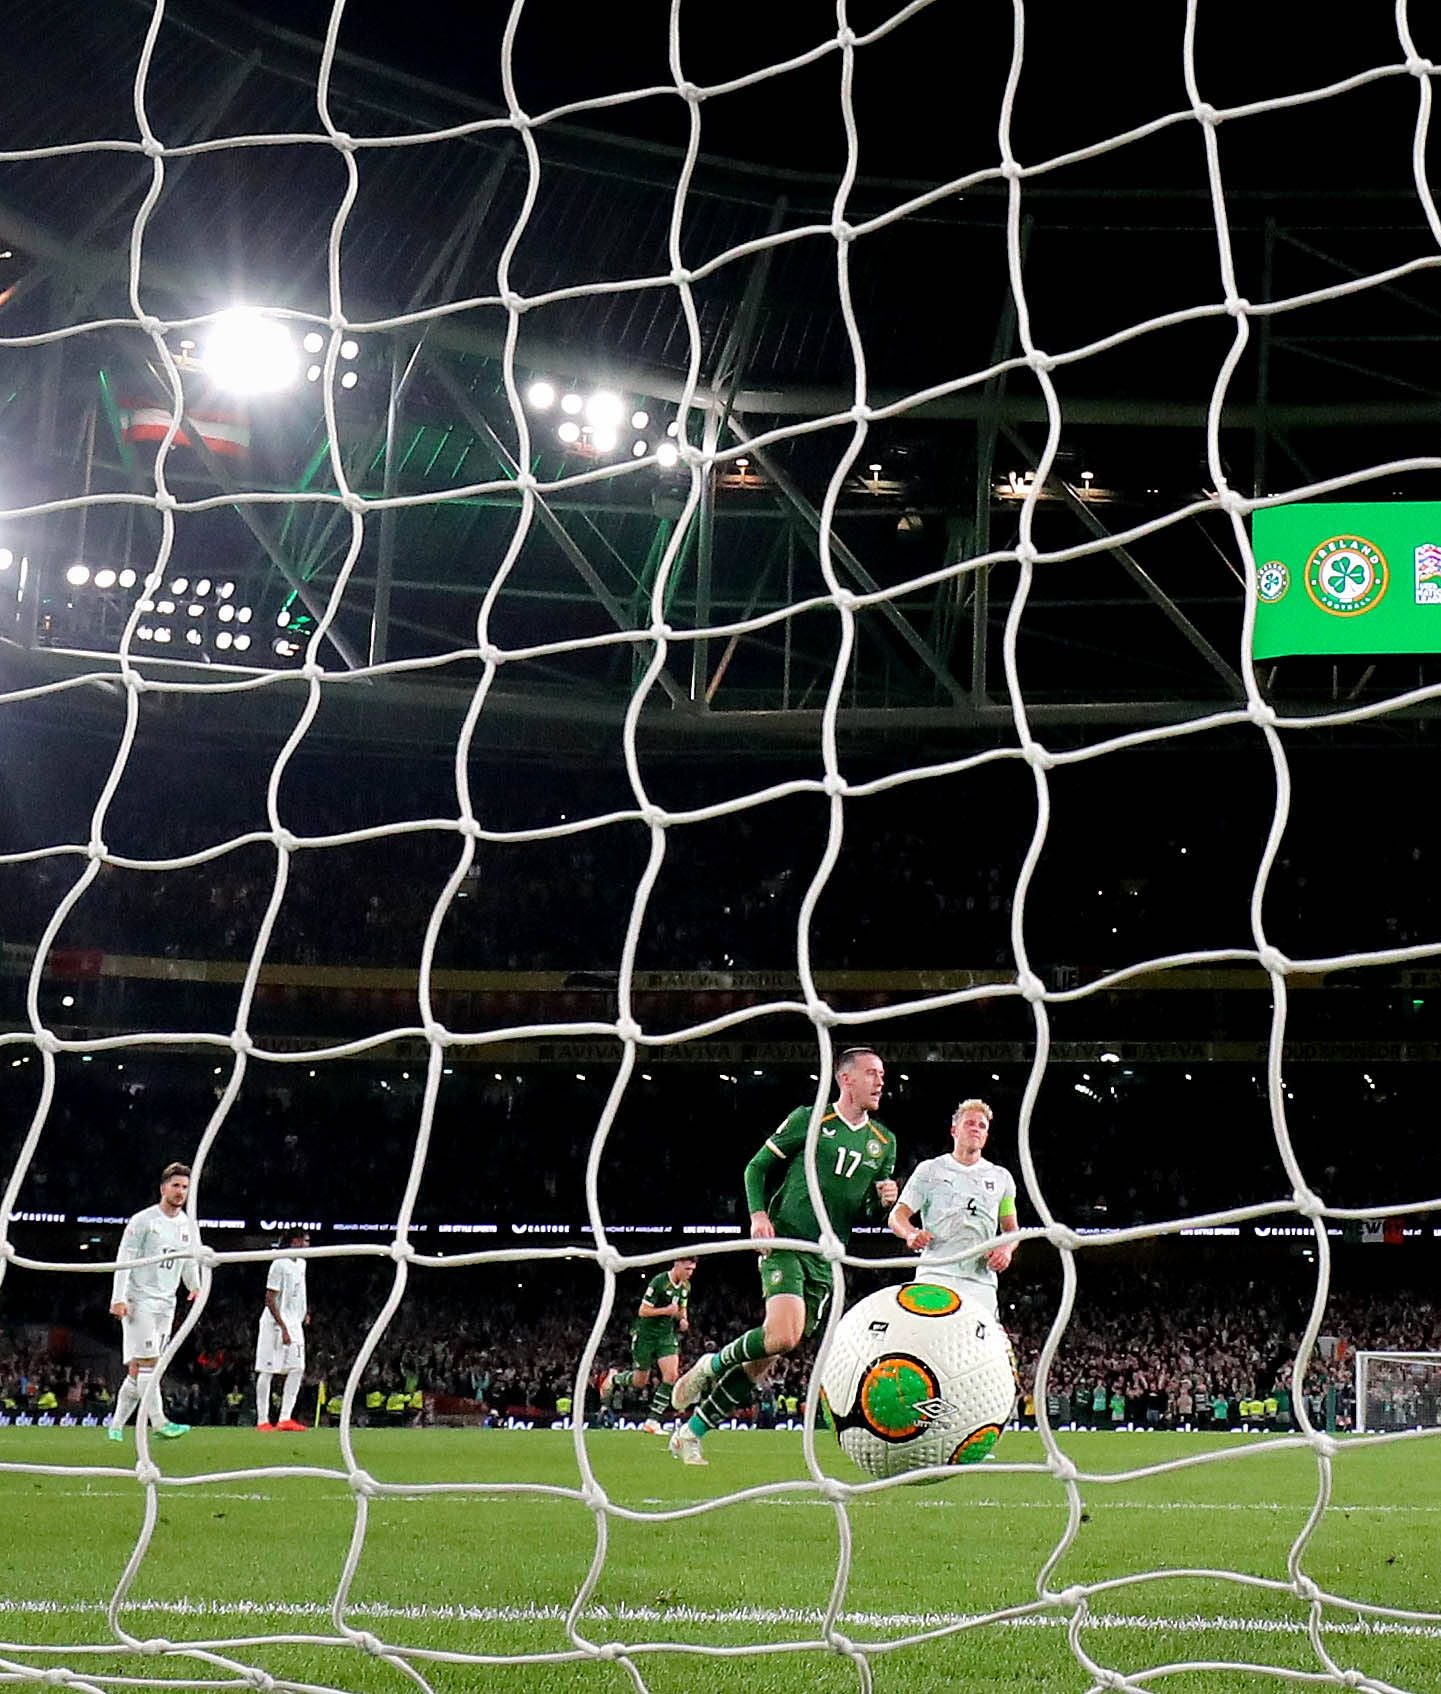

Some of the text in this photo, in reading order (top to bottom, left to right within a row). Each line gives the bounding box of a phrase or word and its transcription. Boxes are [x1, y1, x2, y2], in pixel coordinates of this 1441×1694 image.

[1313, 540, 1380, 566] IRELAND
[834, 1146, 863, 1178] 17
[965, 1198, 977, 1216] 4
